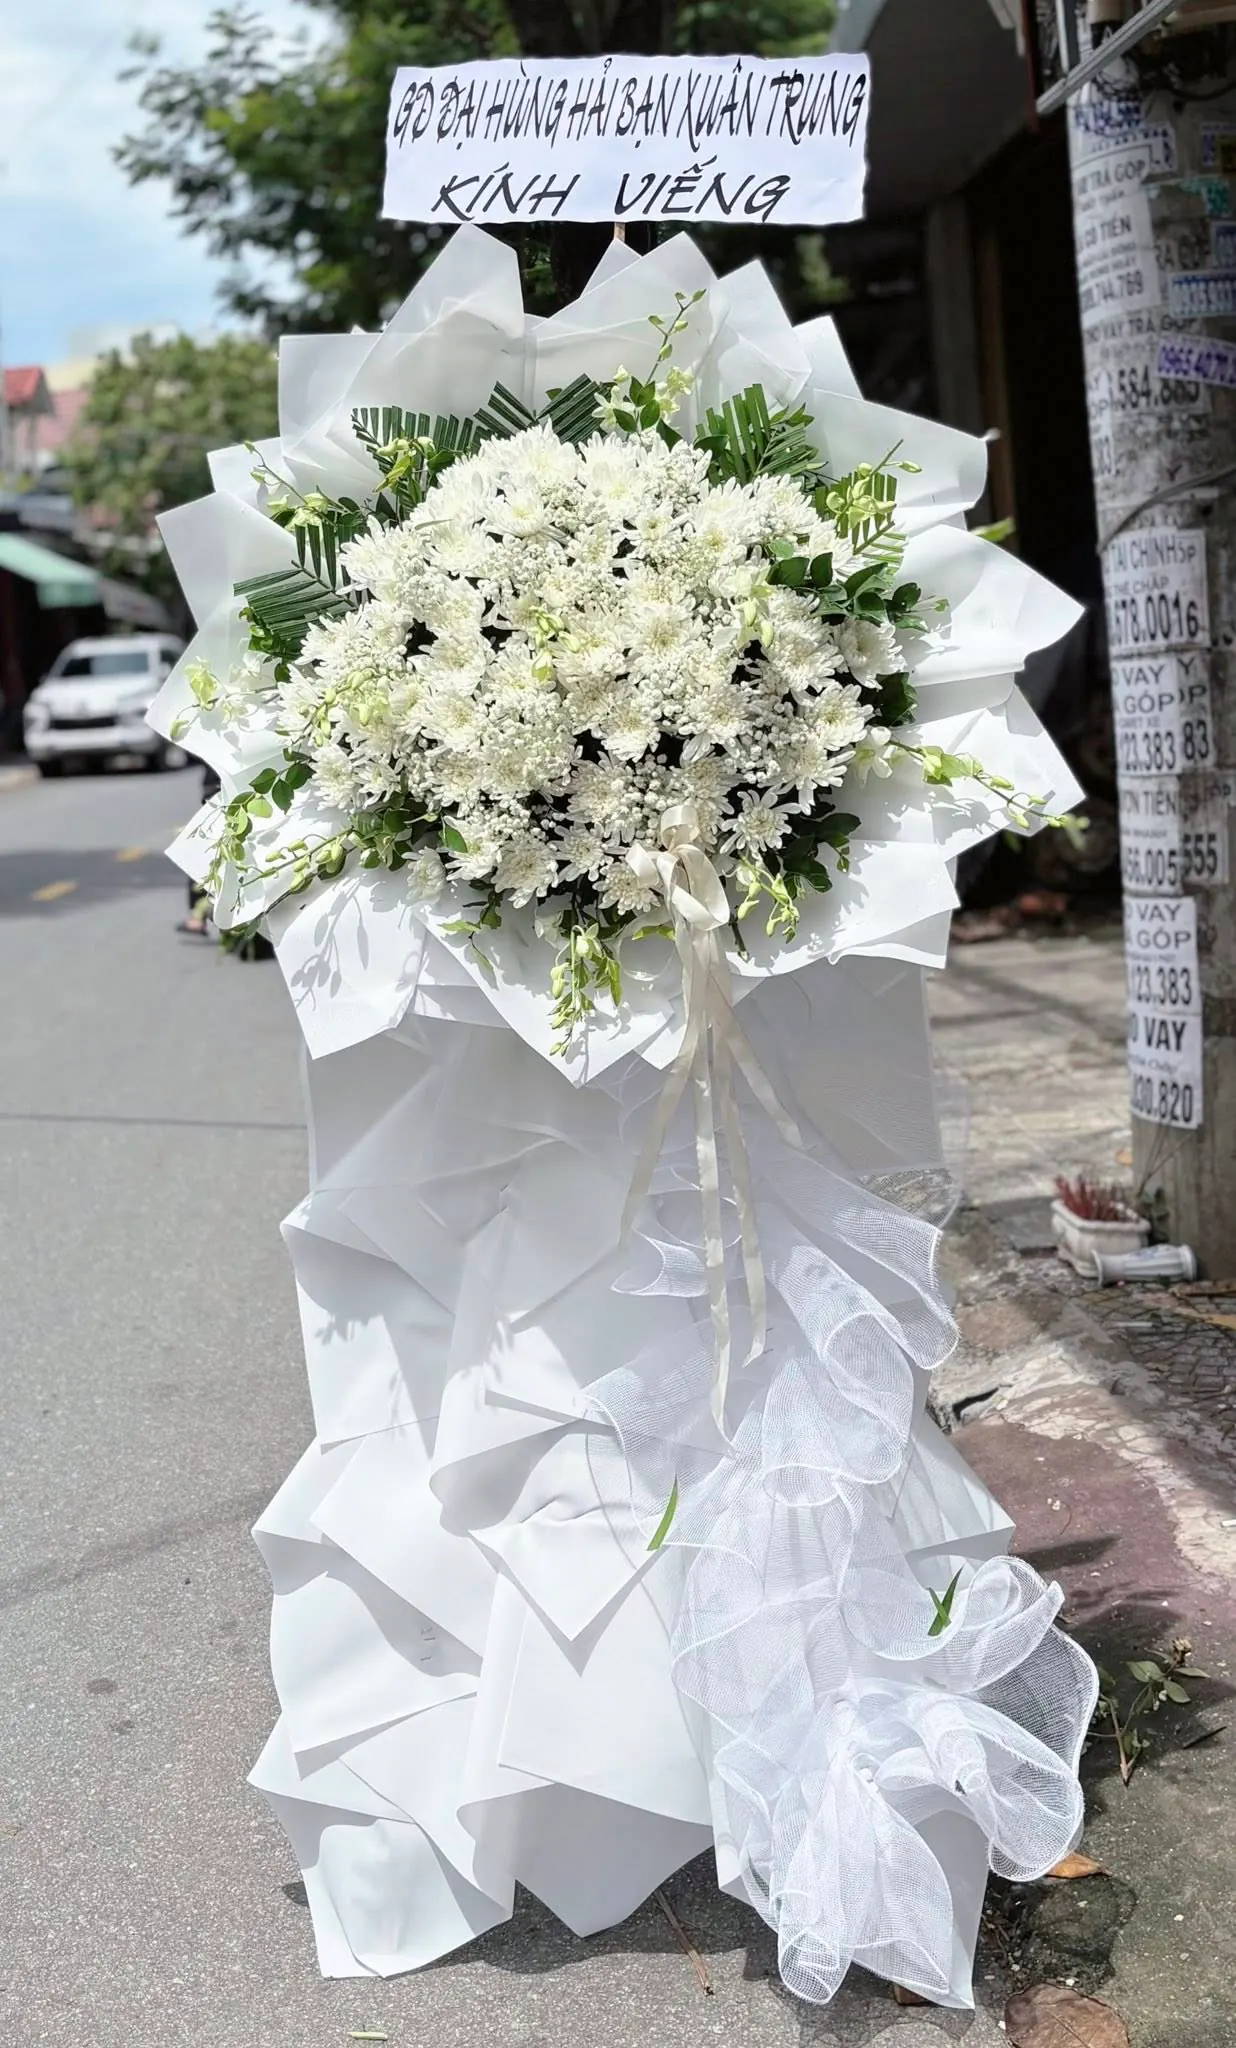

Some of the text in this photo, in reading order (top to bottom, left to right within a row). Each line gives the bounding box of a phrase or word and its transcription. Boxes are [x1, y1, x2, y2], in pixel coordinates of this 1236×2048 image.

[393, 57, 866, 153] GĐ ĐẠI HÙNG HẢI BẠN XUÂN TRUNG
[430, 155, 791, 222] KÍNH VIẾNG
[1122, 665, 1164, 686] VAY
[1136, 903, 1181, 922] VAY
[1144, 1016, 1187, 1051] VAY
